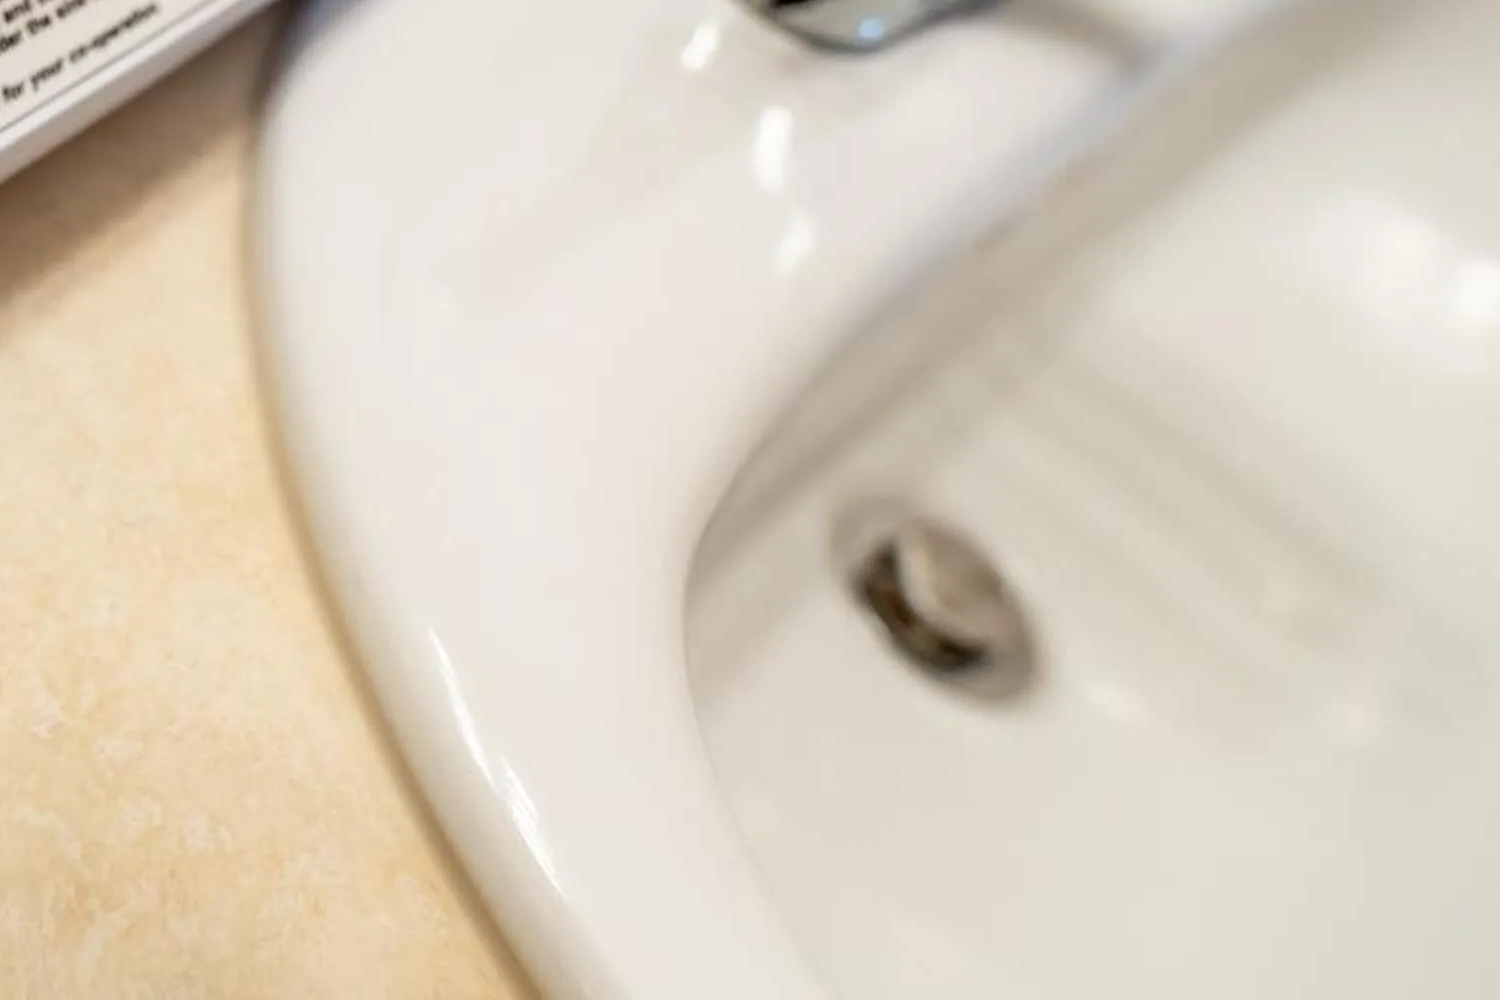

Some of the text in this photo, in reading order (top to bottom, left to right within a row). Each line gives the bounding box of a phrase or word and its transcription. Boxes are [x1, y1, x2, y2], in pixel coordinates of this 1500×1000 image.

[26, 14, 52, 36] the
[2, 80, 25, 101] for
[31, 57, 64, 93] your
